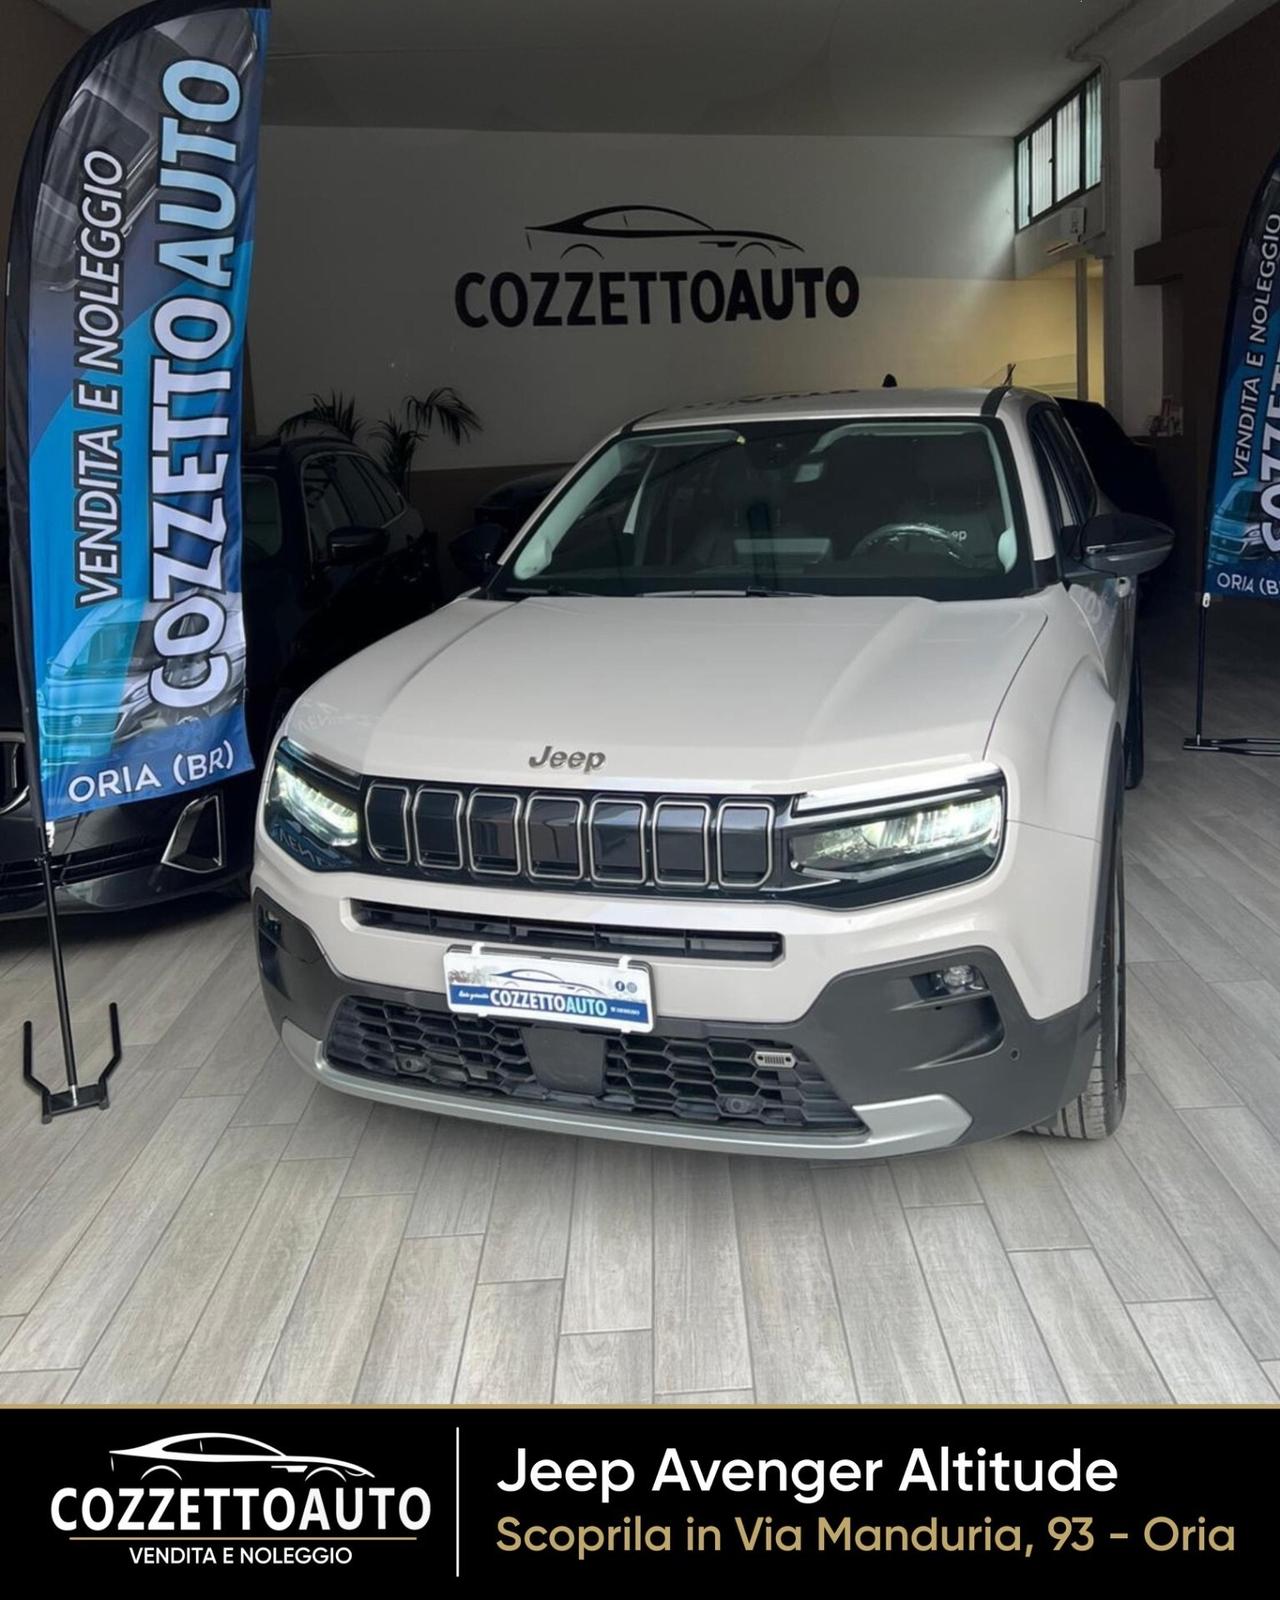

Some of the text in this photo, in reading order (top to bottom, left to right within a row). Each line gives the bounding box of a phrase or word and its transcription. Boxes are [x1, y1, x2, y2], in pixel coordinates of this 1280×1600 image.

[454, 265, 860, 329] COZZETTOAUTO
[1249, 213, 1280, 343] NOLEGGIO
[79, 150, 123, 603] VENDITA E NOLEGGIO
[1246, 351, 1264, 367] E
[1233, 377, 1261, 477] VENDITA
[1217, 572, 1280, 596] ORIA (B
[68, 741, 234, 802] ORIA (BR)
[528, 745, 606, 775] Jeep
[489, 989, 608, 1017] COZZETTOAUTO
